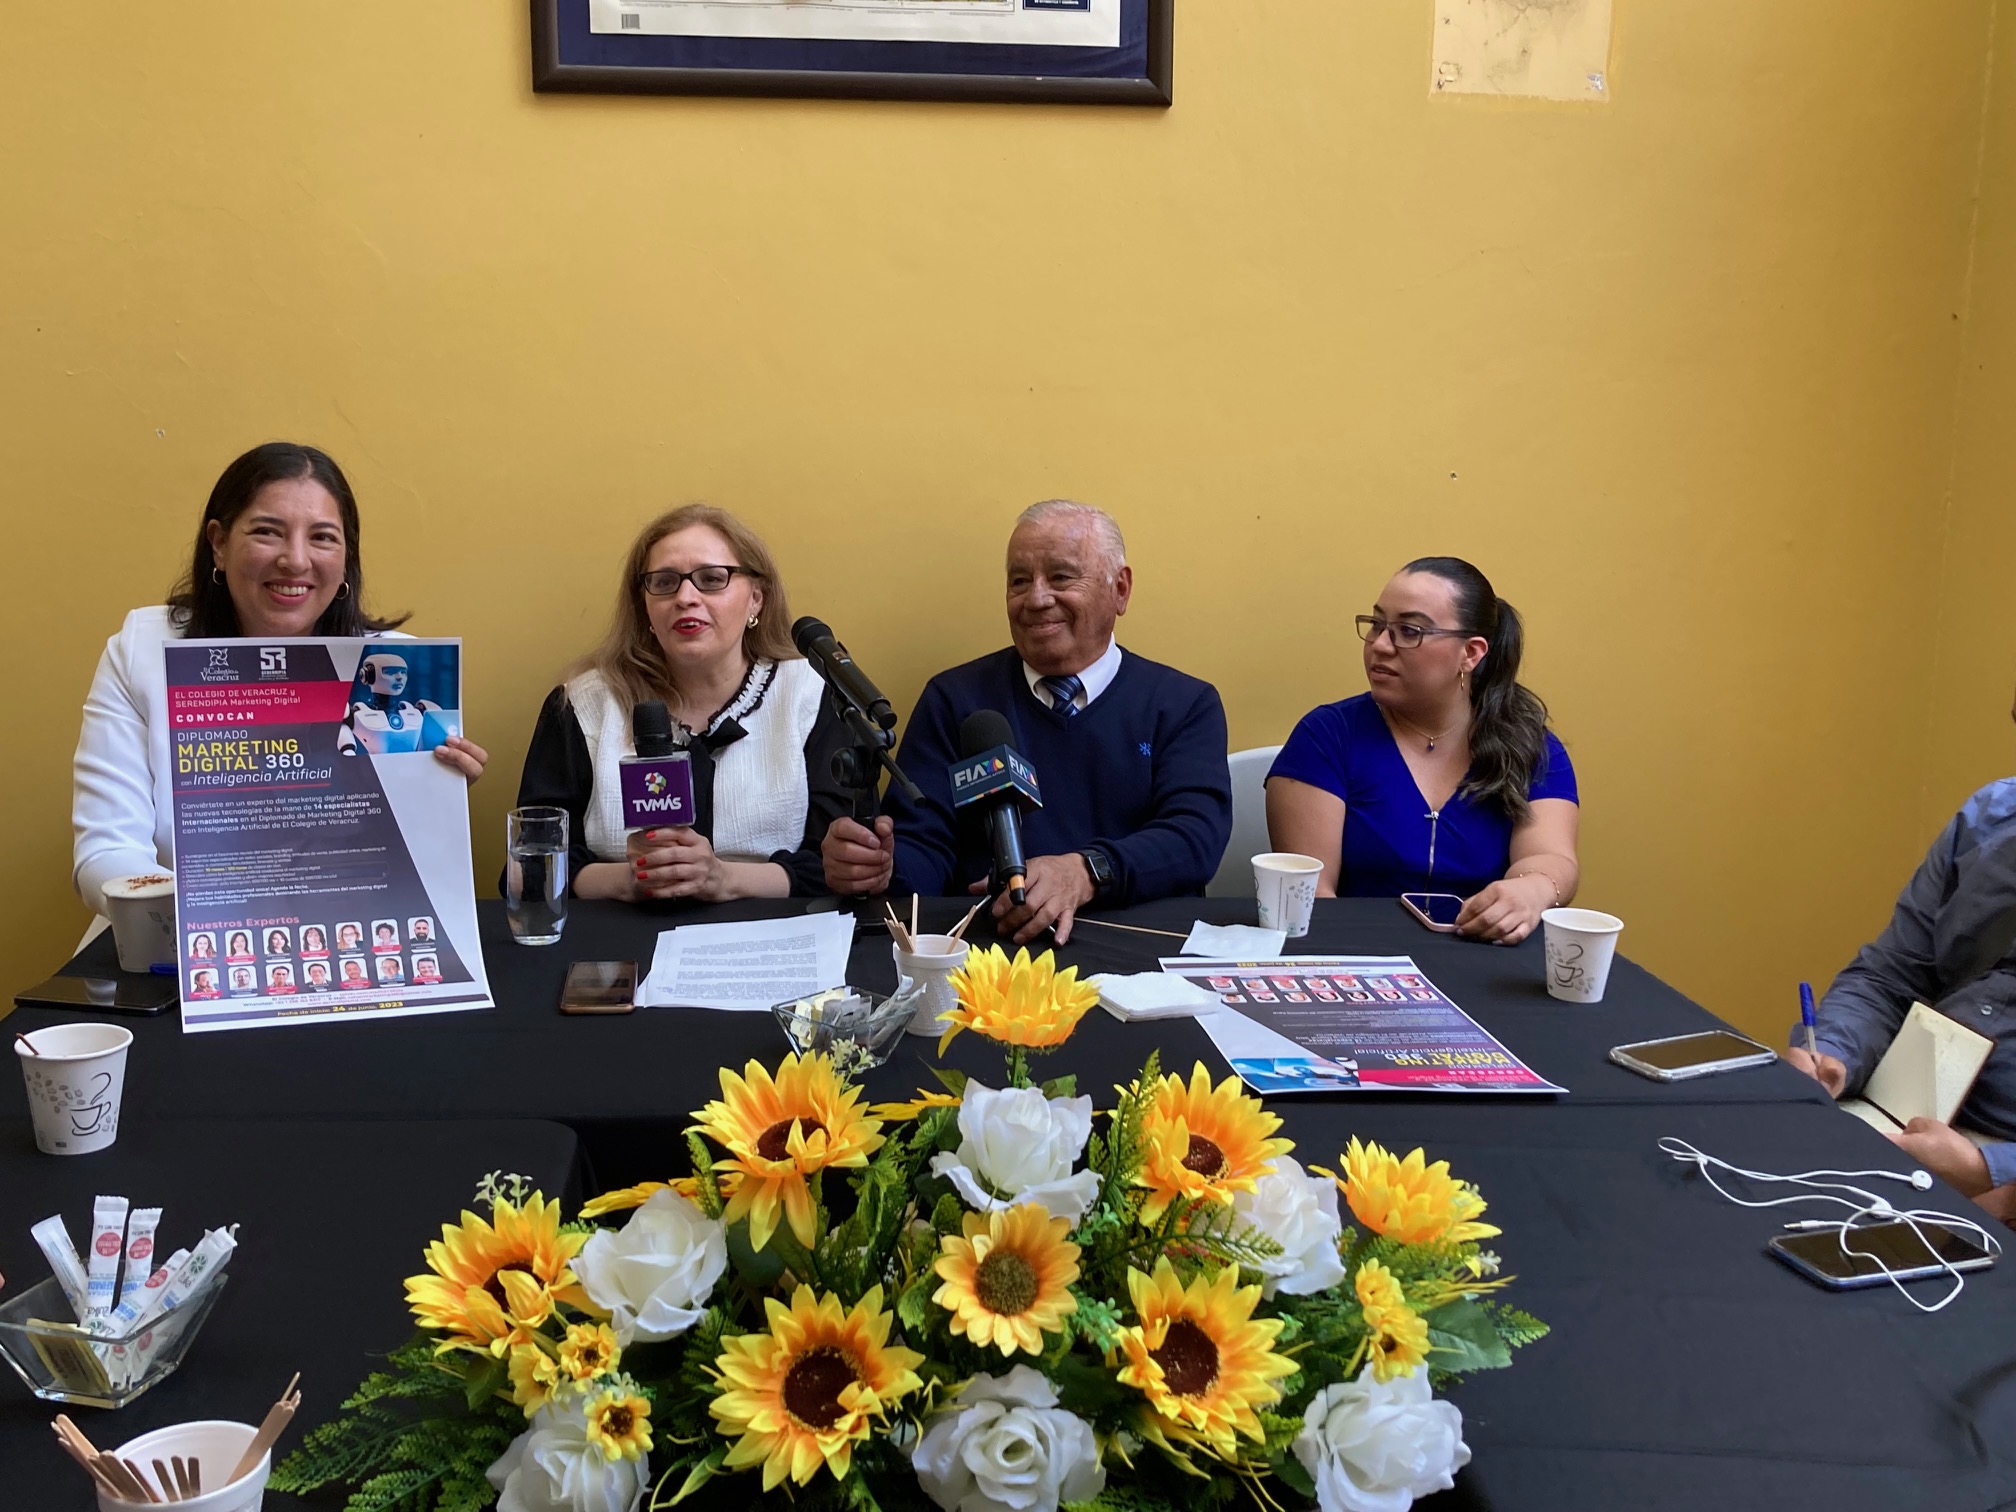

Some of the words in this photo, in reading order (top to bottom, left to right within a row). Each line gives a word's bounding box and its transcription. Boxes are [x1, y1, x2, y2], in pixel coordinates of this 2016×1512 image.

[200, 671, 240, 681] Veracruz
[208, 667, 232, 676] Colegio
[188, 690, 226, 699] COLEGIO
[242, 688, 288, 697] VERACRUZ
[176, 700, 228, 708] SERENDIPIA
[230, 698, 272, 706] Marketing
[274, 696, 301, 706] Digital
[176, 711, 254, 723] CONVOCAN
[177, 730, 248, 742] DIPLOMADO
[178, 738, 299, 758] MARKETING
[179, 756, 259, 774] DIGITAL
[266, 753, 305, 769] 360
[193, 770, 272, 787] Inteligencia
[275, 766, 332, 781] Artificial
[181, 801, 224, 810] Conviértete
[346, 792, 380, 800] aplicando
[324, 801, 370, 810] especialistas
[632, 794, 682, 812] TVMÁS
[182, 816, 239, 826] Internacionales
[258, 813, 295, 822] Diplomado
[344, 809, 365, 818] Digital
[198, 825, 239, 834] Inteligencia
[240, 822, 270, 830] Artificial
[290, 820, 316, 828] Colegio
[187, 920, 243, 931] Nuestros
[246, 916, 300, 928] Expertos
[1410, 1047, 1486, 1056] Inteligencia
[88, 1306, 110, 1317] Zulka
